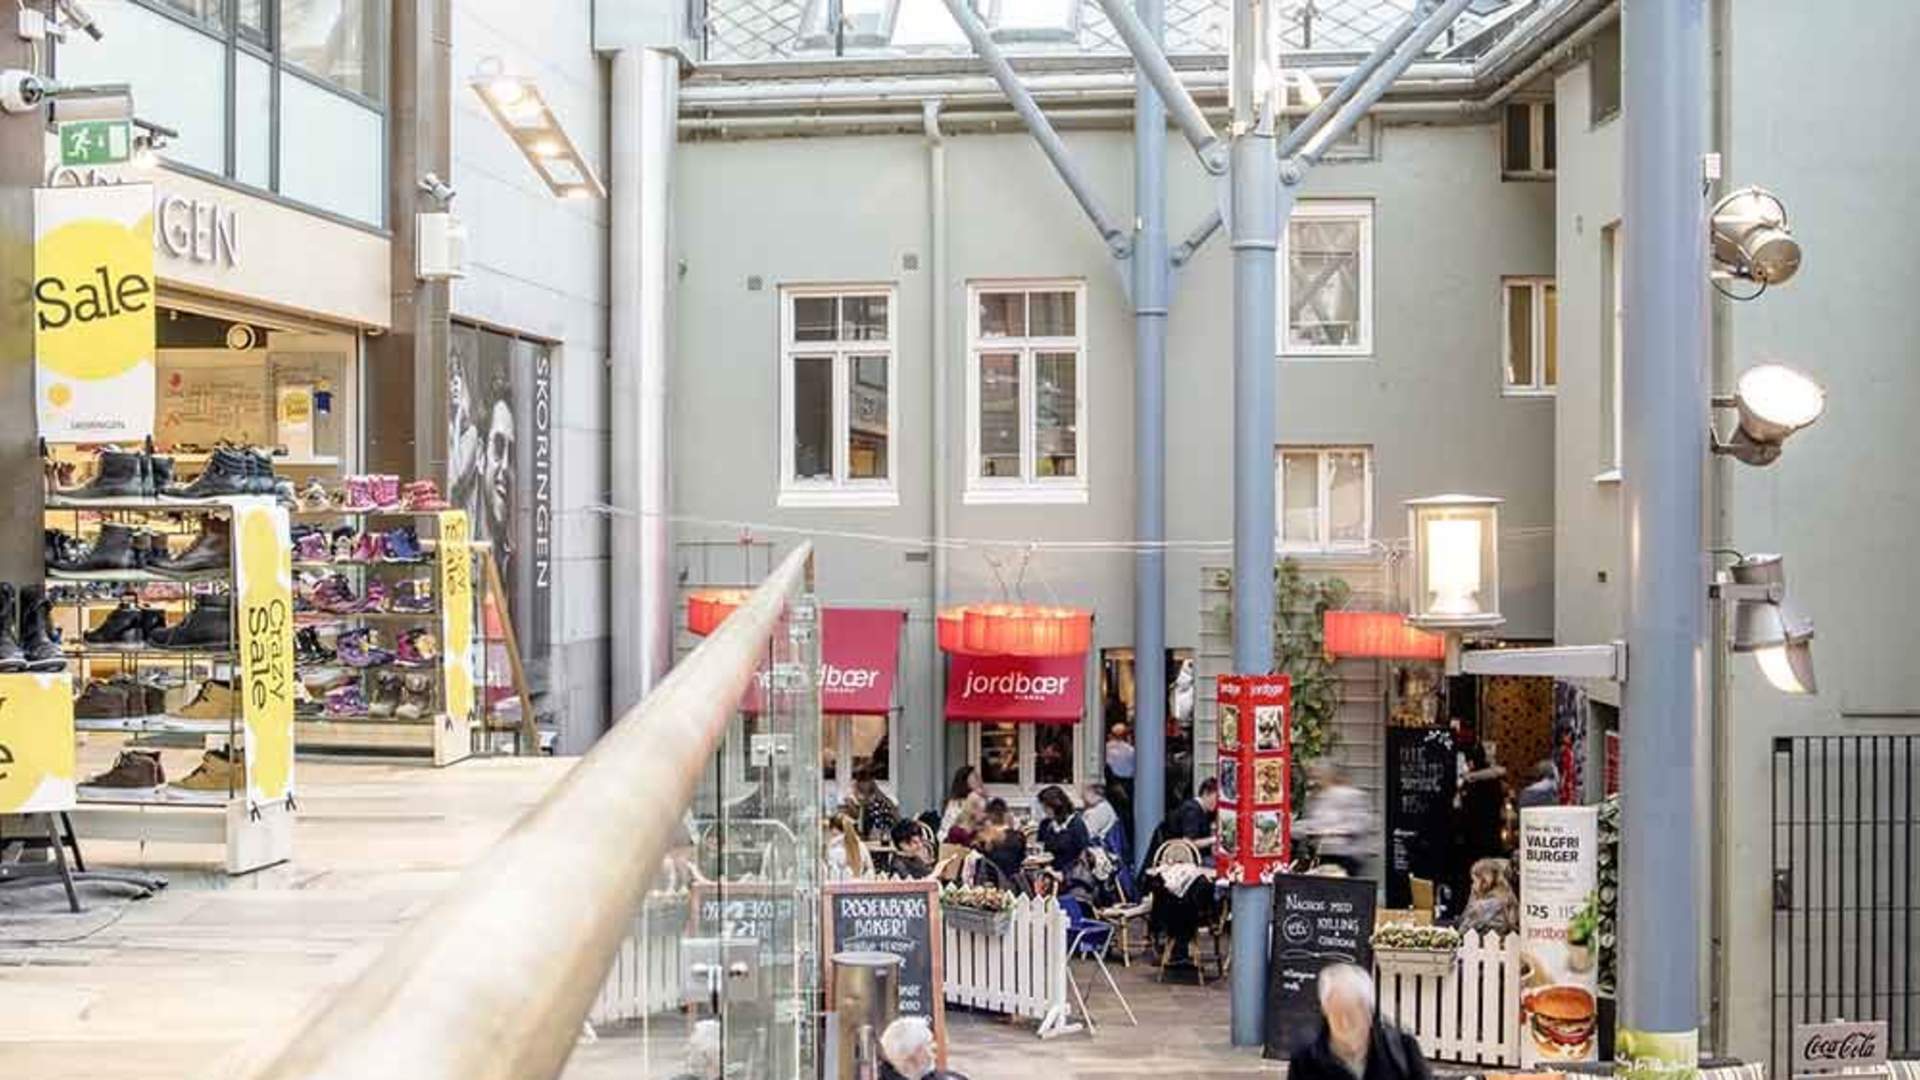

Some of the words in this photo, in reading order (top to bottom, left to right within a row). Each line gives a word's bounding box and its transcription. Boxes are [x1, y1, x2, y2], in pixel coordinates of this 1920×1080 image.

[34, 265, 151, 332] Sale
[536, 356, 550, 588] SKORINGEN
[249, 606, 271, 710] Sale
[269, 599, 287, 700] Crazy
[961, 669, 1070, 699] jordbær
[1526, 835, 1580, 849] VALGFRI
[1526, 849, 1579, 862] BURGER
[1526, 905, 1549, 919] 125
